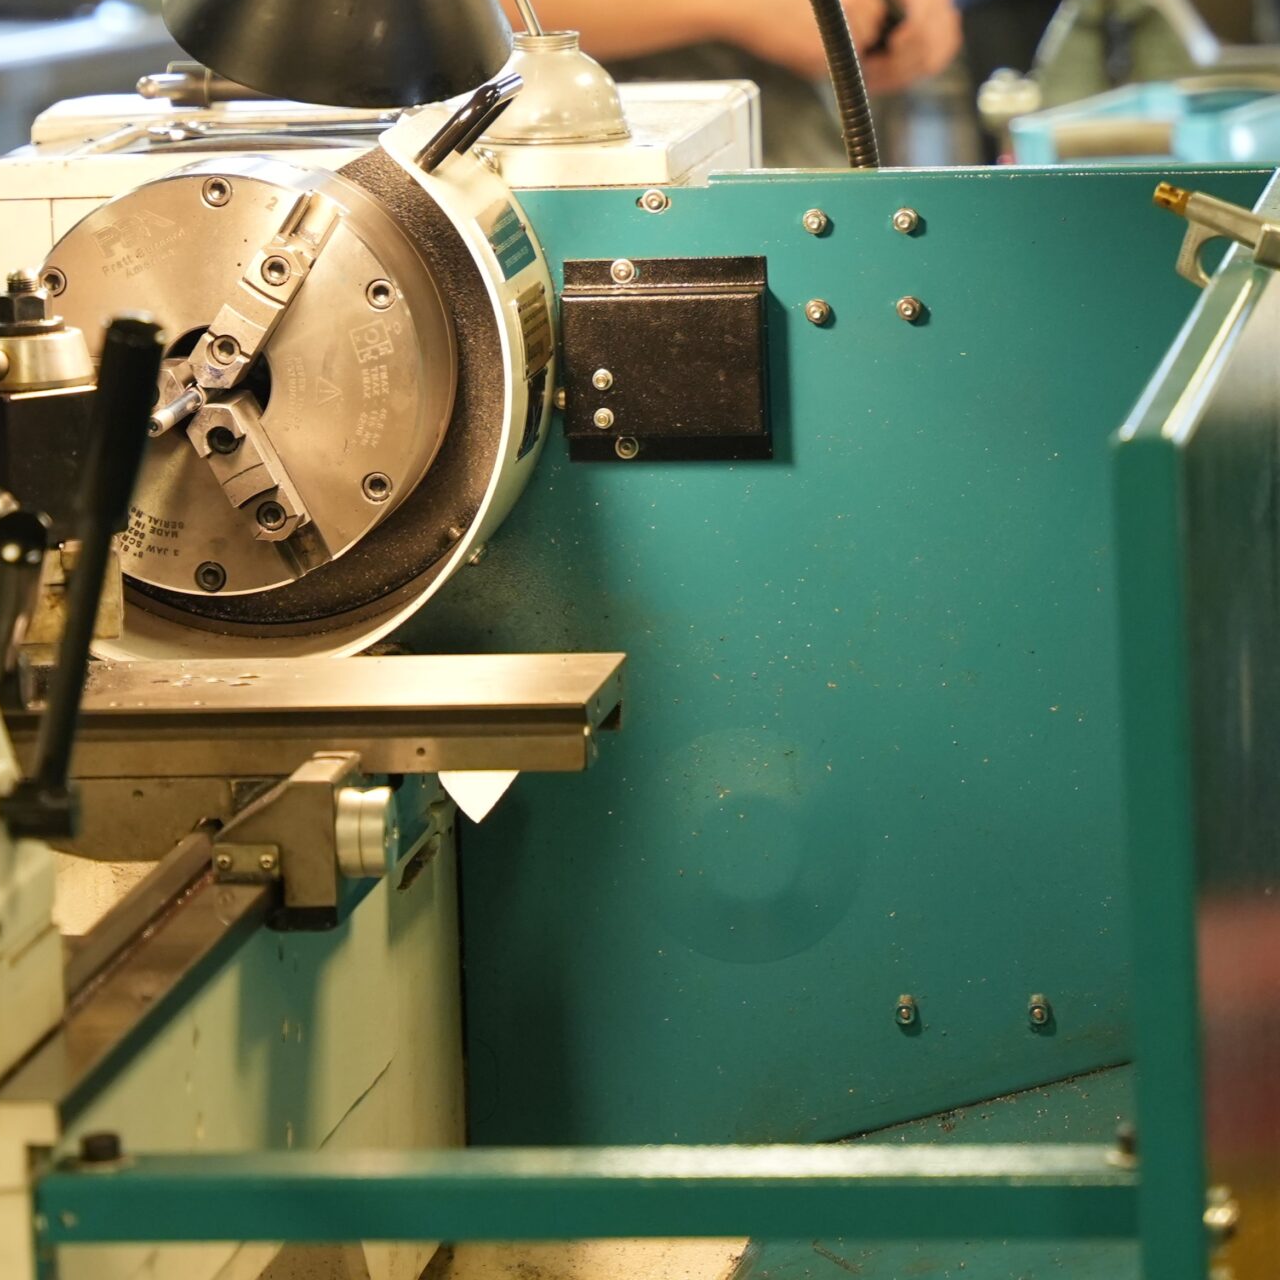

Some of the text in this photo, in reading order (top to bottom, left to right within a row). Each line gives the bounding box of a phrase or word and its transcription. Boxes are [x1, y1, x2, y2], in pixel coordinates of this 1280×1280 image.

[148, 515, 184, 529] SERIAL
[135, 520, 178, 539] MADE IN
[146, 545, 169, 555] JAW
